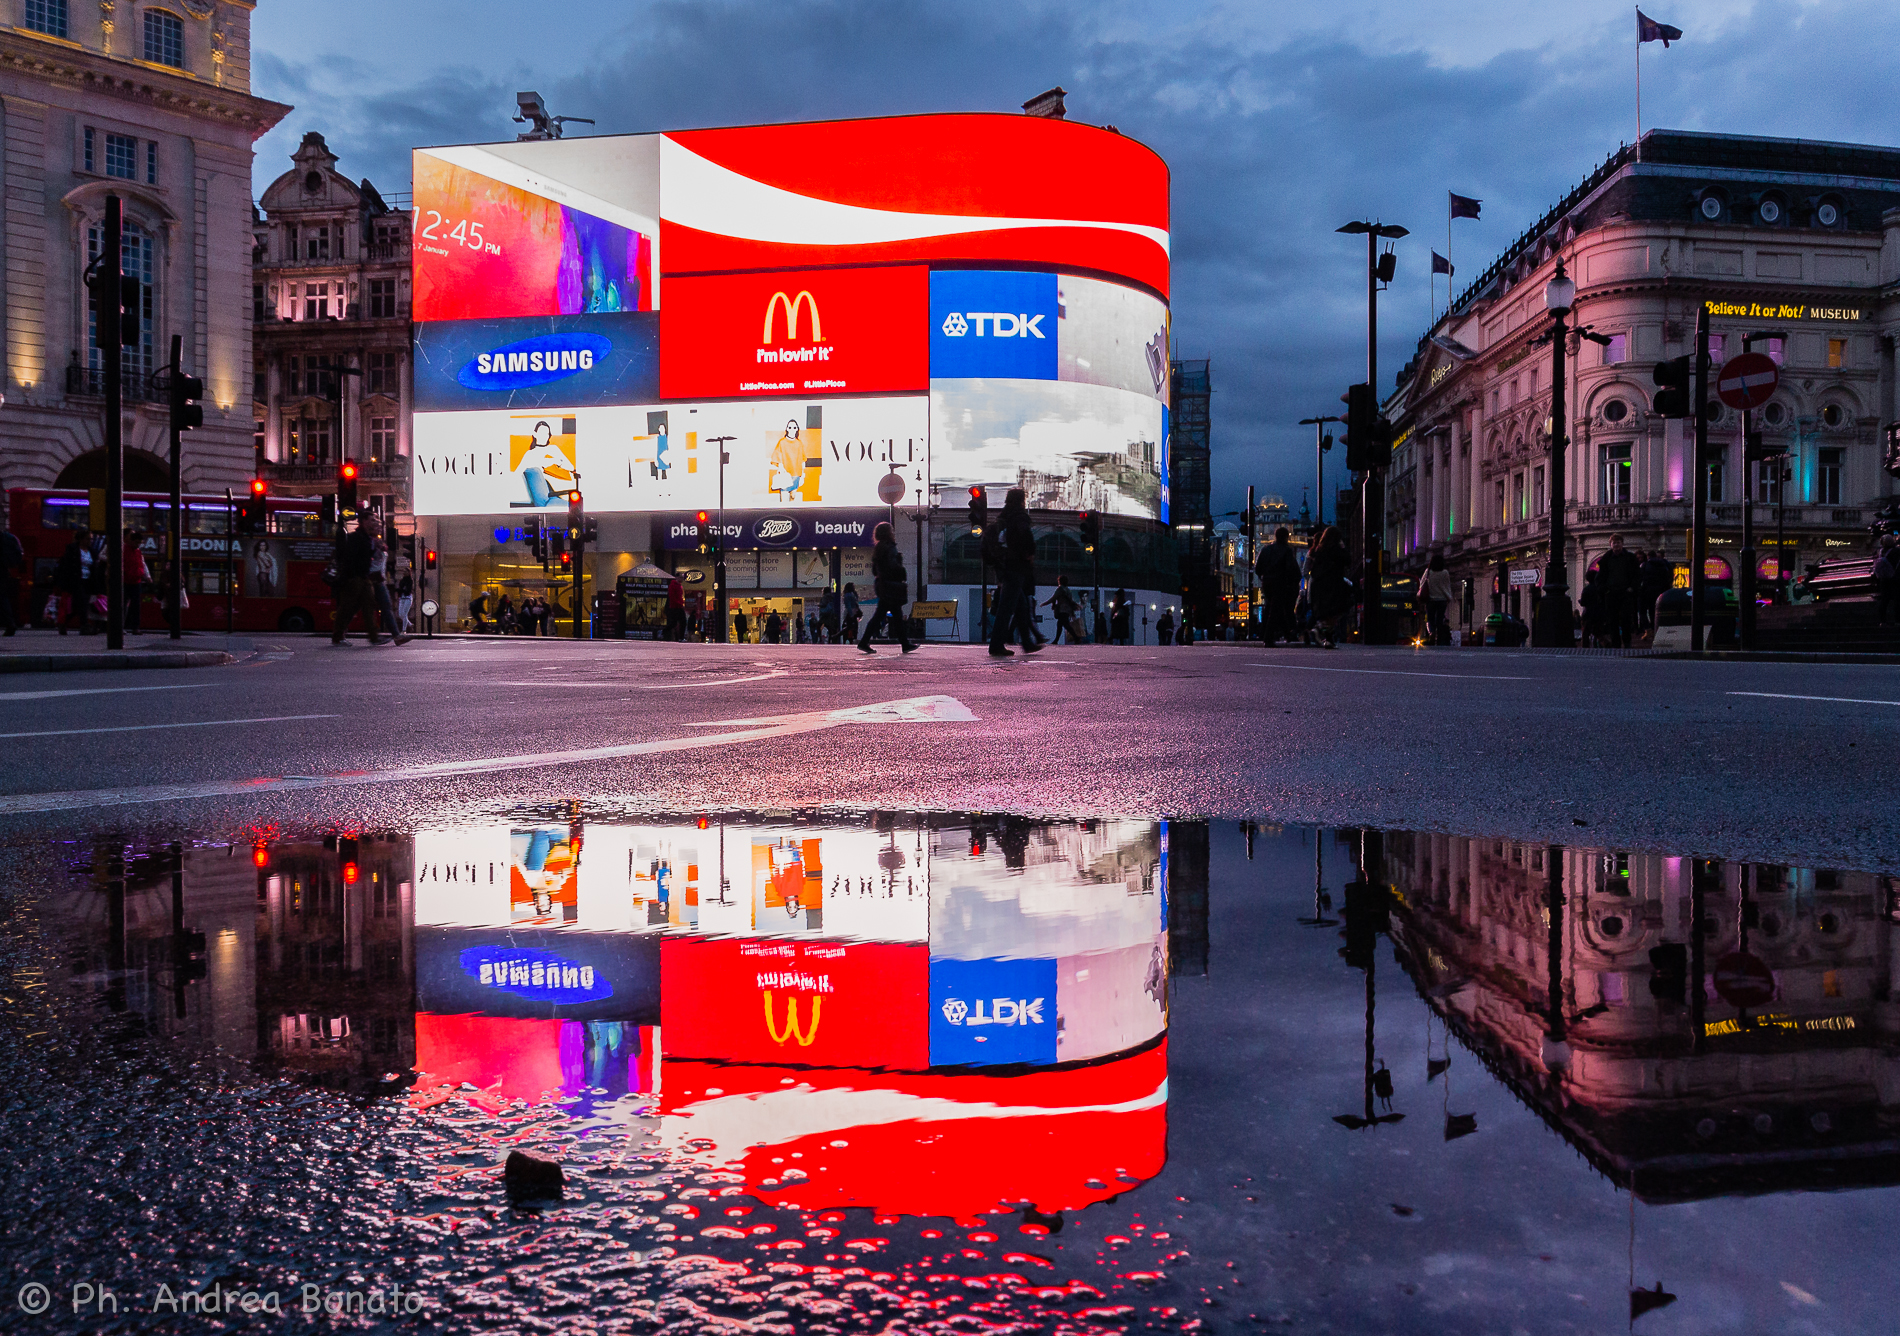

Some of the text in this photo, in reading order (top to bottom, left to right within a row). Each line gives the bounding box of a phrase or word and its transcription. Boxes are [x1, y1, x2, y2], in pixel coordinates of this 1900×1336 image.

[413, 205, 501, 256] 12:45 PM
[1705, 300, 1860, 320] Believe It or Not! MUSEUM
[966, 312, 1046, 339] TDK
[477, 349, 593, 374] SAMSUNG
[758, 519, 793, 538] Boots
[815, 520, 865, 537] beauty
[762, 557, 779, 565] store
[844, 563, 863, 571] open
